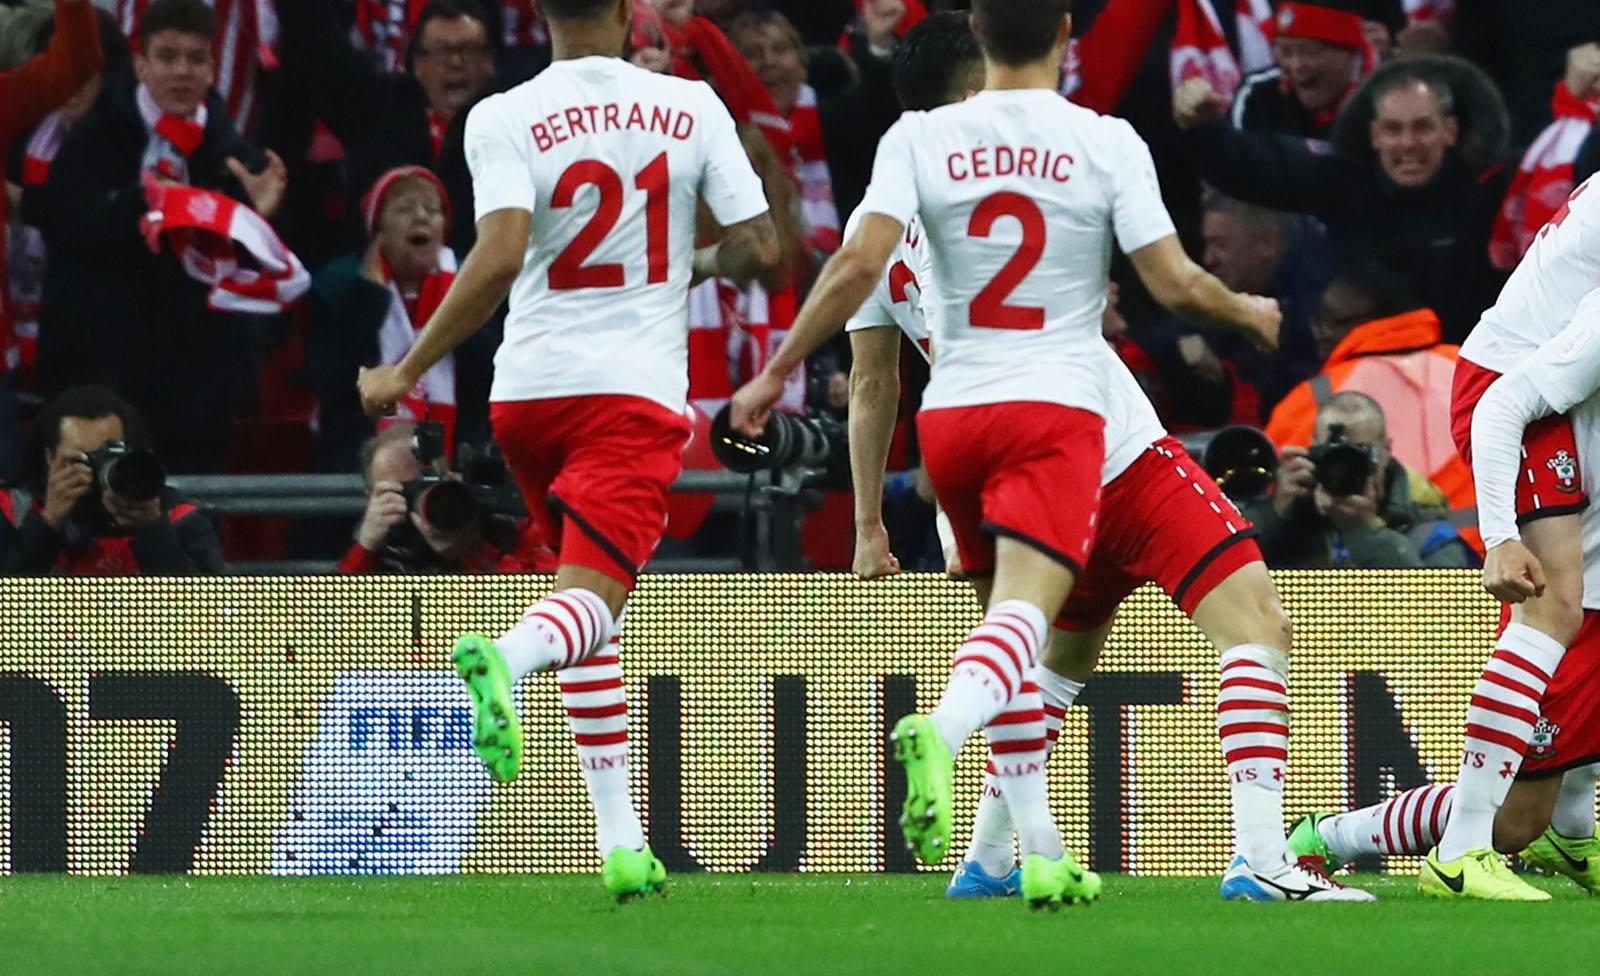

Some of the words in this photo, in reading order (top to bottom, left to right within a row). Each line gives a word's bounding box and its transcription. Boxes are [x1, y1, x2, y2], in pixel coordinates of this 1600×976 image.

[530, 102, 695, 153] BERTRAND
[947, 139, 1075, 184] CÉDRIC
[547, 150, 671, 291] 21
[966, 190, 1047, 331] 2
